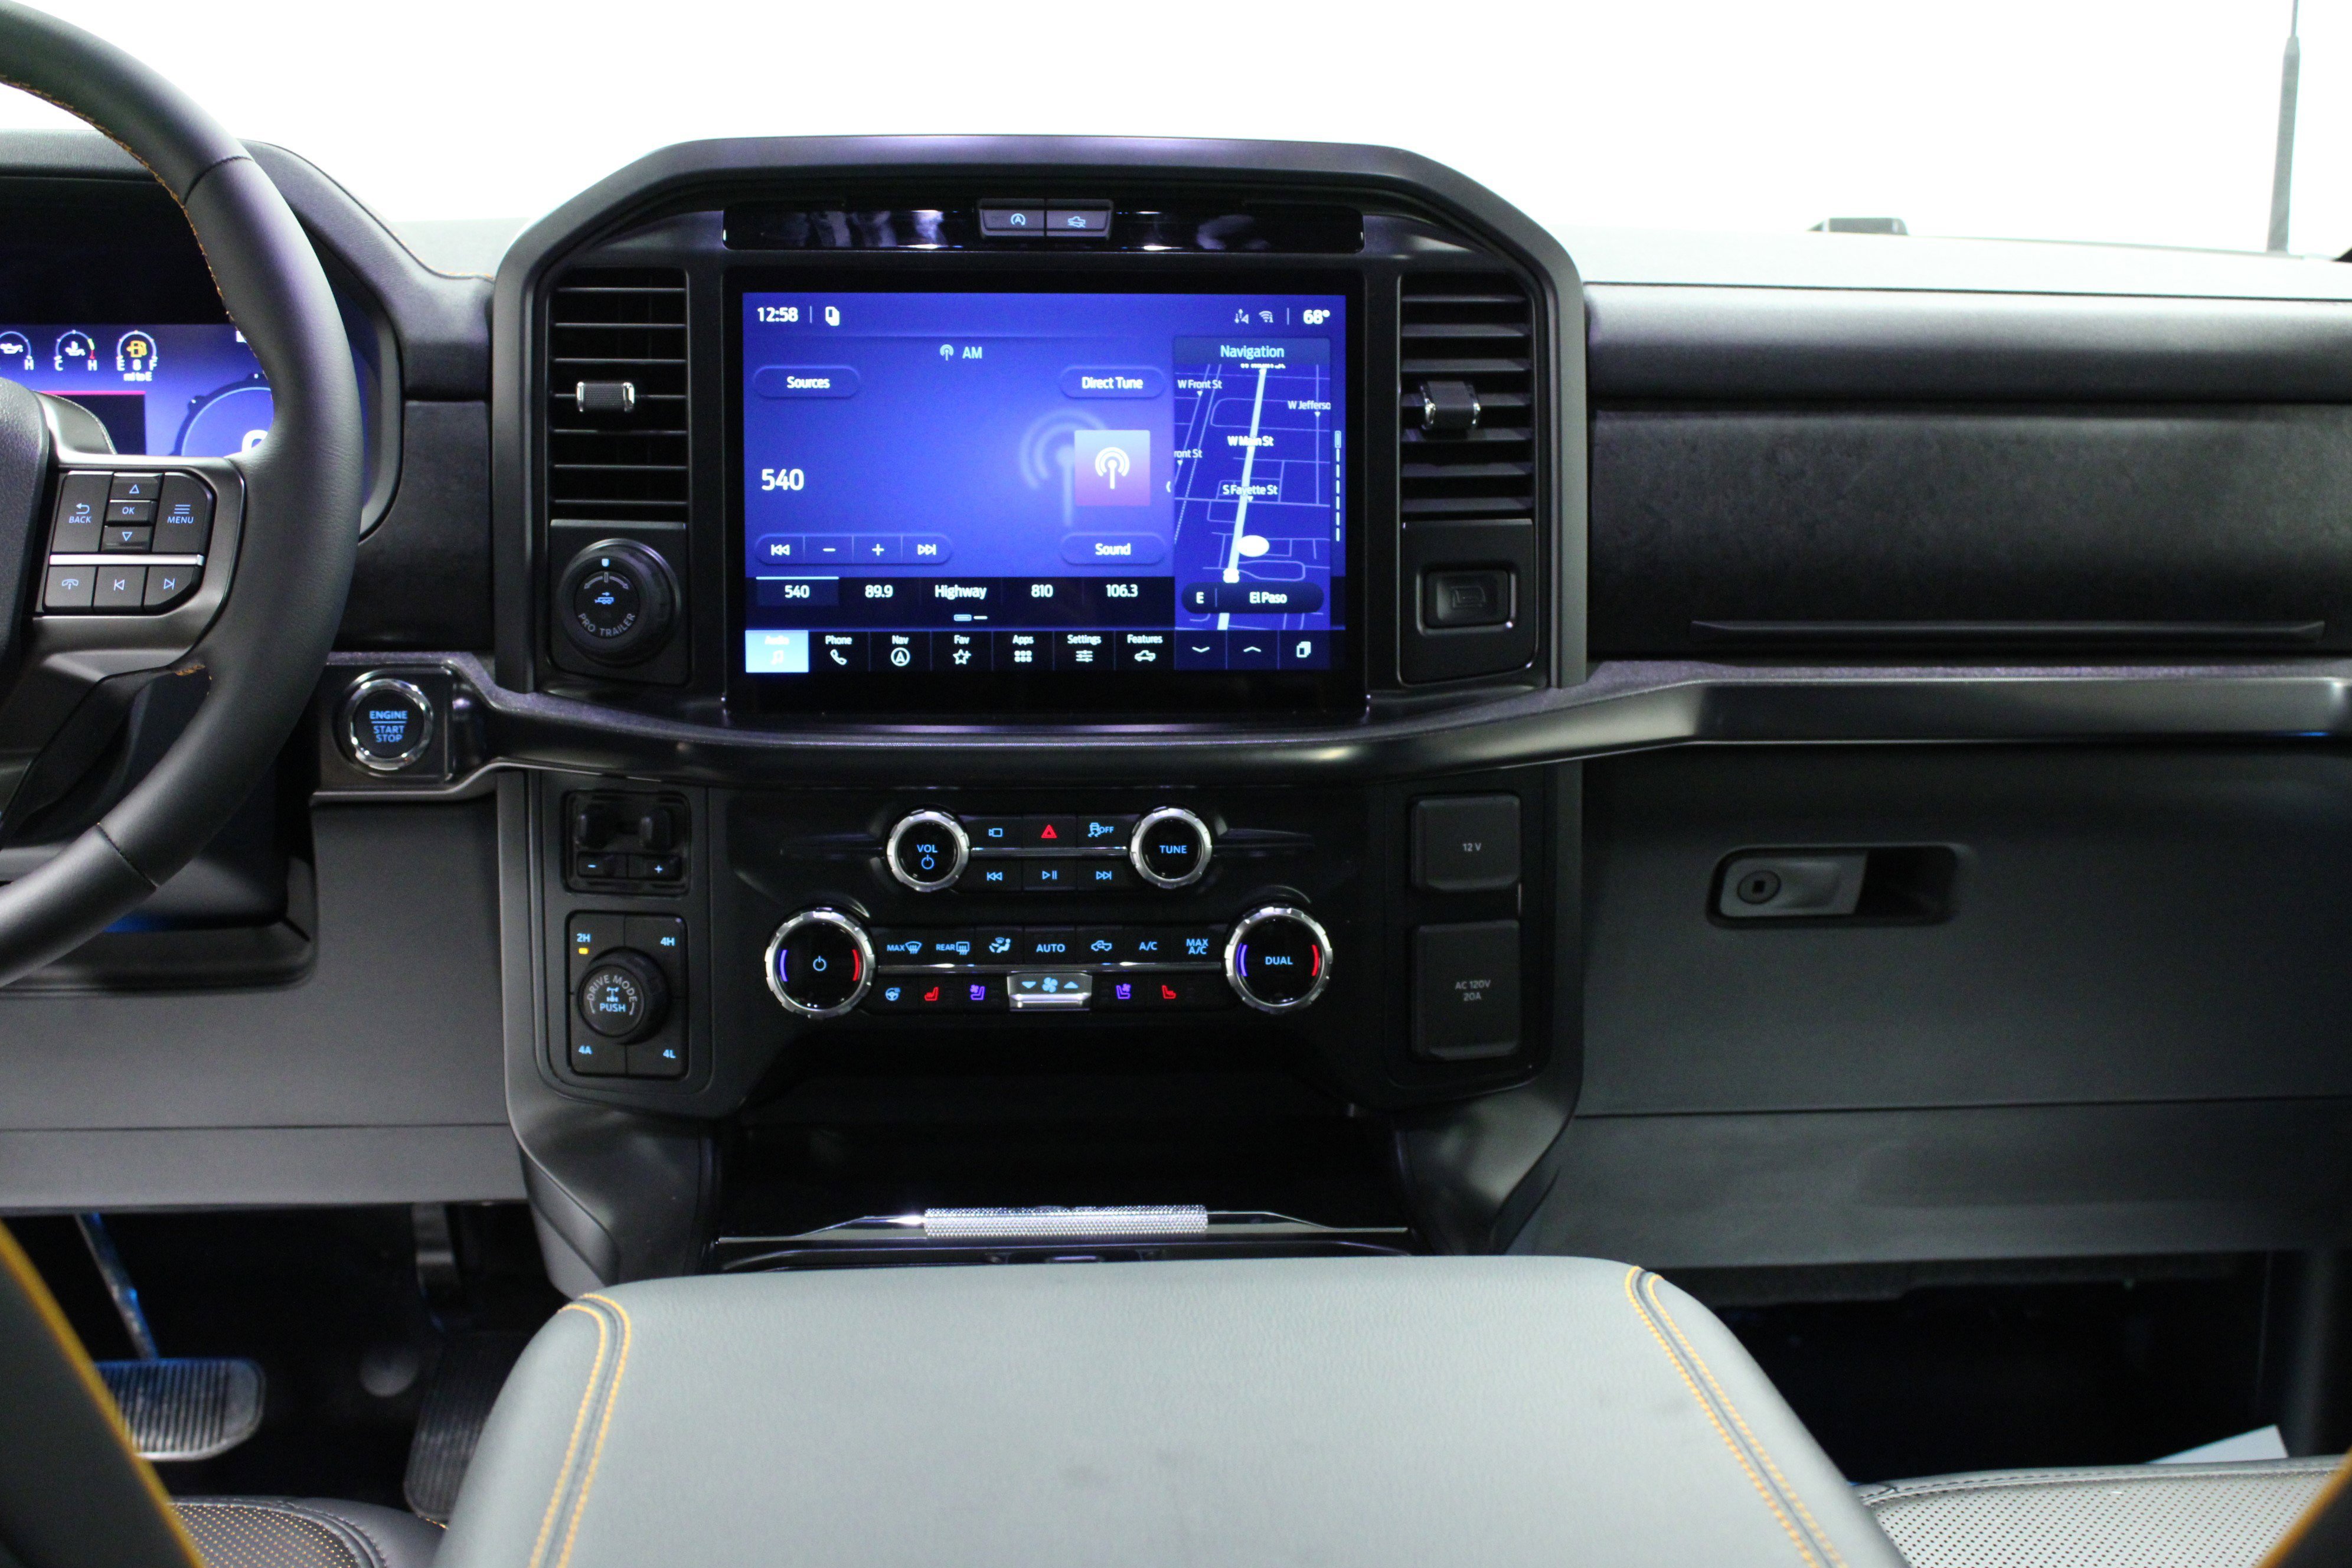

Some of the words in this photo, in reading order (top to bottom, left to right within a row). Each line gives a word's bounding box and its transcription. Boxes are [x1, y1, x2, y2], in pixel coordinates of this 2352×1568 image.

[757, 306, 799, 322] 12:58
[962, 346, 982, 359] AM
[1220, 345, 1285, 360] Navigation
[24, 359, 34, 370] H
[54, 360, 64, 371] C
[87, 360, 98, 371] H
[116, 359, 126, 371] E
[149, 359, 158, 371] F
[786, 375, 831, 389] Sources
[1082, 376, 1113, 390] Direct
[1115, 376, 1144, 390] Tune
[1177, 379, 1187, 389] W
[1187, 379, 1211, 389] Front
[1212, 379, 1223, 389] St
[1287, 400, 1298, 410] W
[1227, 435, 1239, 447] W
[1239, 435, 1262, 447] Main
[1262, 435, 1274, 447] St
[1192, 449, 1203, 458] St
[762, 468, 805, 491] 540
[1222, 484, 1230, 495] S
[1230, 484, 1266, 496] Fayette
[1267, 484, 1278, 495] St
[122, 507, 135, 515] OK
[68, 515, 92, 524] BACK
[167, 516, 194, 524] MENU
[1095, 543, 1131, 556] Sound
[785, 584, 810, 599] 540
[865, 584, 894, 599] 89.9
[935, 584, 987, 600] Highway
[1031, 584, 1054, 598] 810
[1106, 584, 1139, 597] 106.3
[1195, 591, 1204, 604] E
[1249, 591, 1261, 604] El
[1261, 591, 1288, 604] Paso
[577, 612, 597, 633] PRO
[599, 612, 636, 637] TRAILER
[764, 635, 790, 646] Audio
[825, 635, 852, 645] Phone
[891, 635, 909, 645] Nav
[953, 634, 970, 645] Fav
[1012, 634, 1034, 646] Apps
[1067, 634, 1102, 646] Settings
[1126, 633, 1163, 644] Features
[369, 710, 407, 720] ENGINE
[373, 725, 404, 734] START
[375, 734, 403, 743] STOP
[1099, 825, 1114, 835] OFF
[917, 844, 938, 853] VOL
[1159, 845, 1187, 854] TUNE
[1463, 842, 1473, 852] 12
[1475, 842, 1482, 851] V
[576, 933, 591, 943] 2H
[660, 937, 675, 946] 4H
[1186, 938, 1208, 946] MAX
[1036, 943, 1066, 953] AUTO
[1139, 941, 1158, 951] A/C
[1188, 946, 1207, 955] A/C
[1265, 956, 1293, 965] DUAL
[586, 975, 610, 1001] DRIVE
[613, 975, 638, 1002] MODE
[1455, 981, 1467, 990] AC
[1469, 979, 1491, 989] 120V
[1463, 991, 1482, 1002] 20A
[599, 1002, 626, 1012] PUSH
[578, 1045, 592, 1055] 4A
[662, 1049, 676, 1059] 4L
